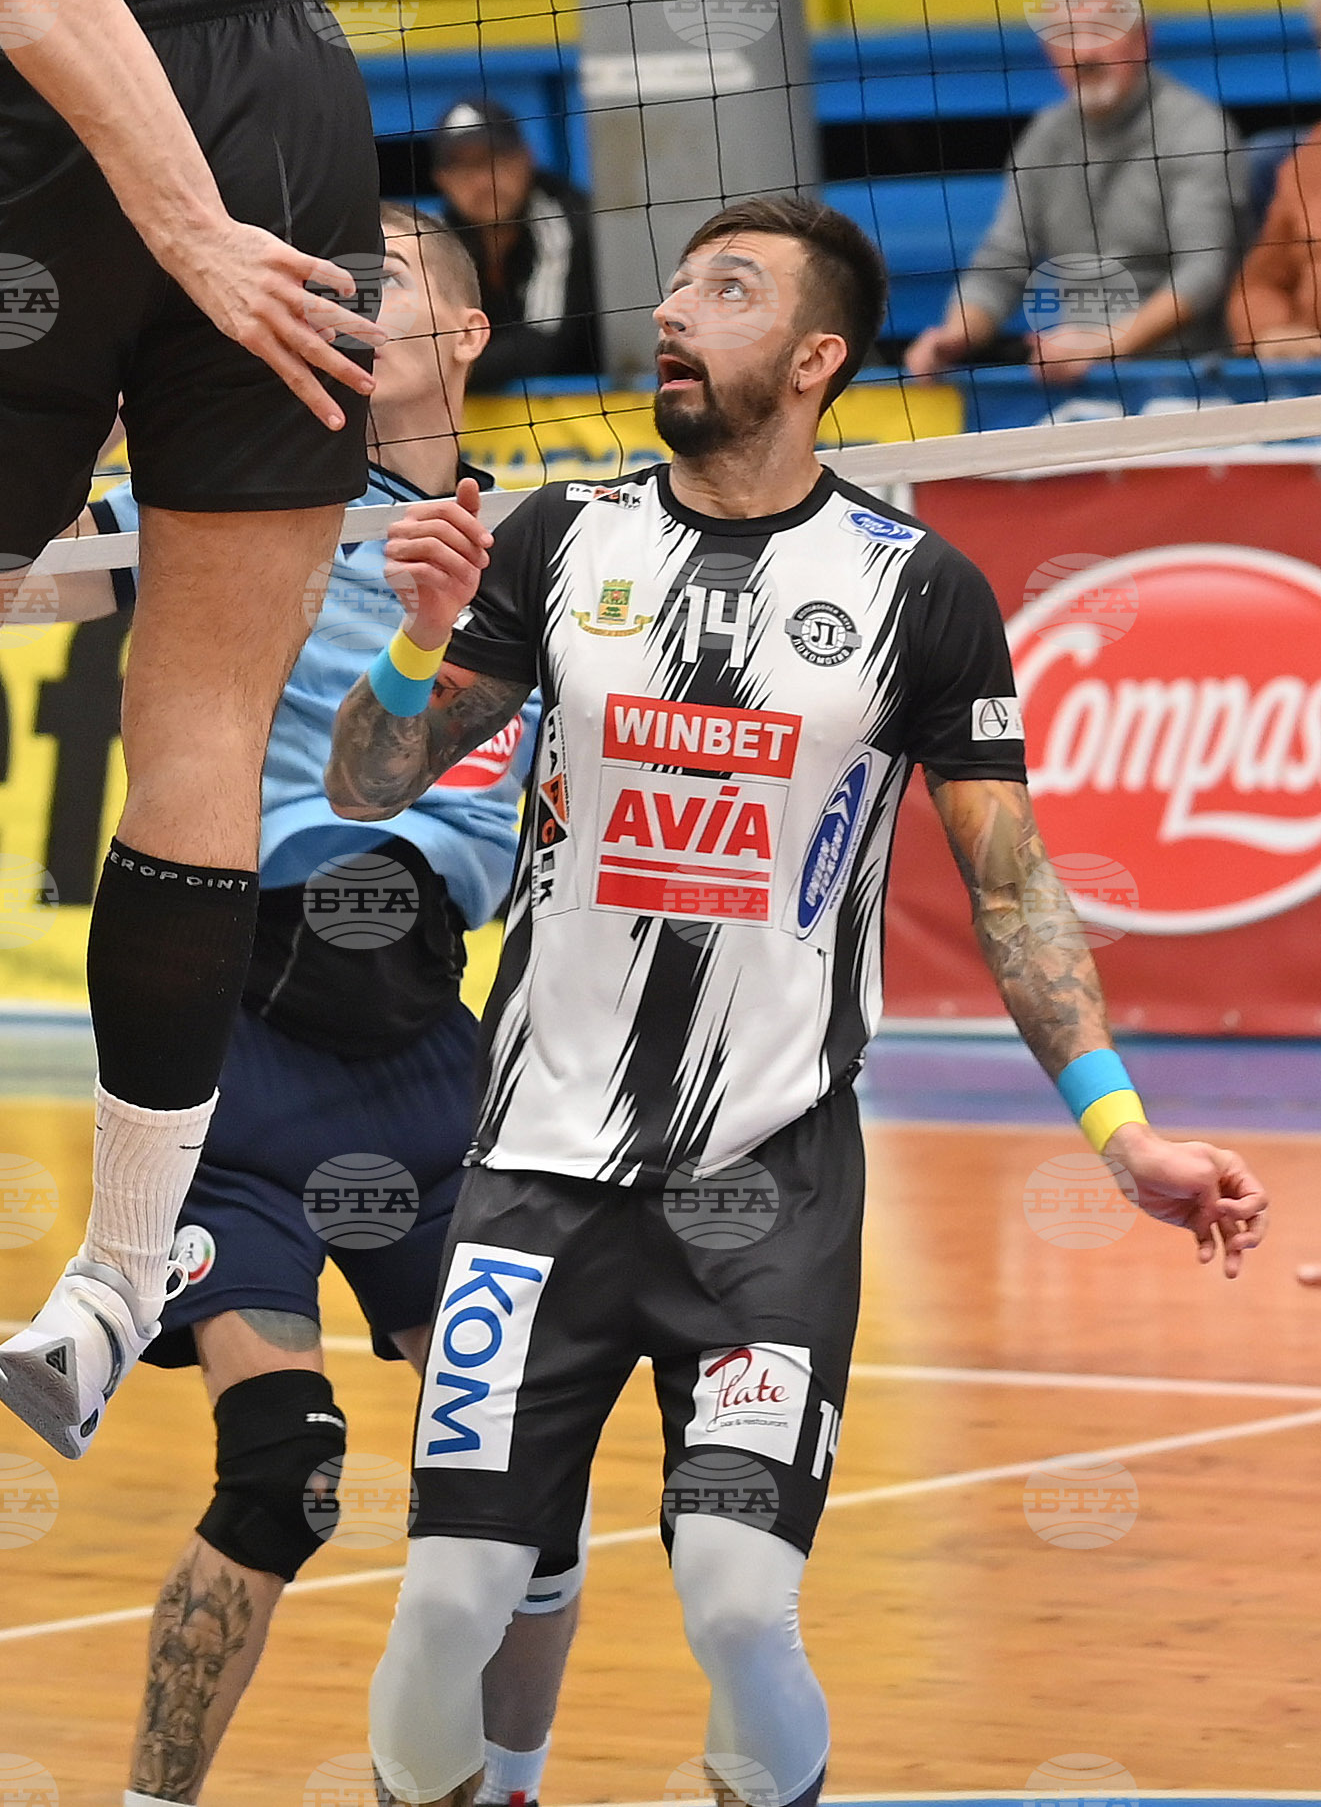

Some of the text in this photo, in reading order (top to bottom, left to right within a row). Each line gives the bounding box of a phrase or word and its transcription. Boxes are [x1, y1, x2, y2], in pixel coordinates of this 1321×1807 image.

[681, 583, 754, 669] 14
[614, 706, 794, 761] WINBET
[704, 1347, 790, 1422] Plate
